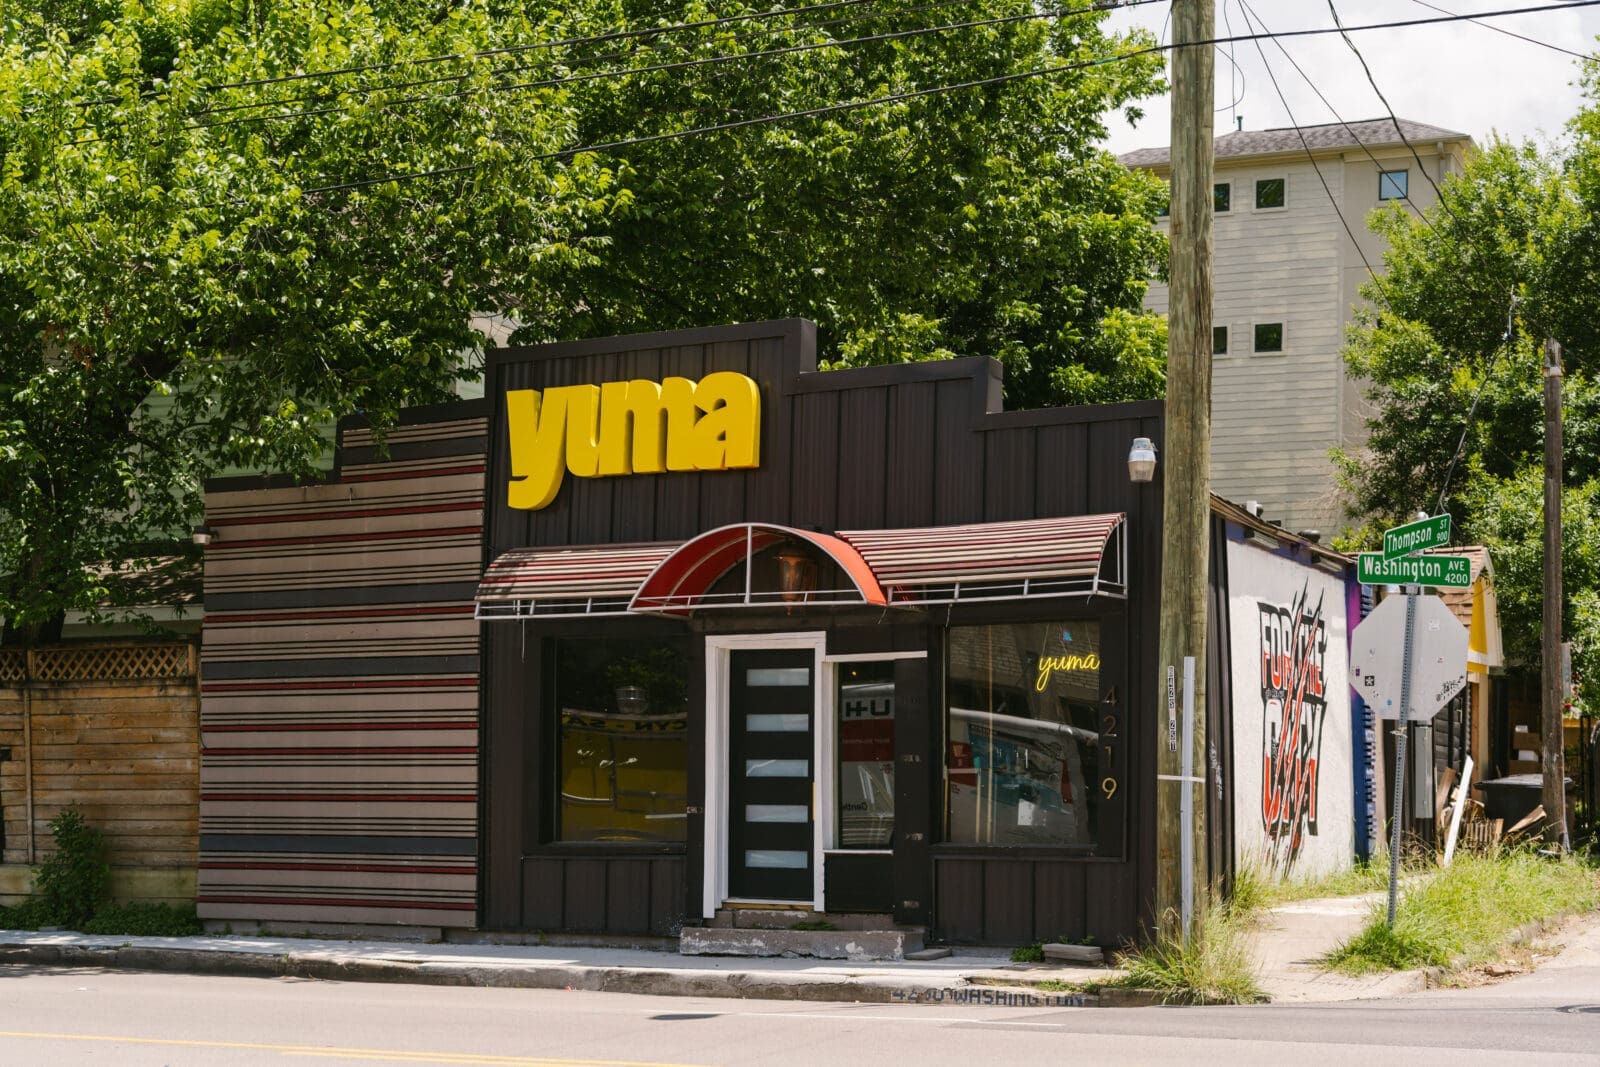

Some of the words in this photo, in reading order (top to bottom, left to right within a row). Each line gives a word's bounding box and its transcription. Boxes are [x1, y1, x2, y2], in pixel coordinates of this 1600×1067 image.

[506, 371, 761, 511] yuma
[1440, 519, 1447, 529] ST
[1387, 527, 1431, 552] Thompson
[1436, 531, 1447, 542] 900
[1364, 557, 1440, 581] Washington
[1444, 573, 1468, 583] 4200
[1448, 561, 1464, 571] AVE
[1036, 652, 1100, 691] yuma
[1102, 687, 1118, 800] 4219
